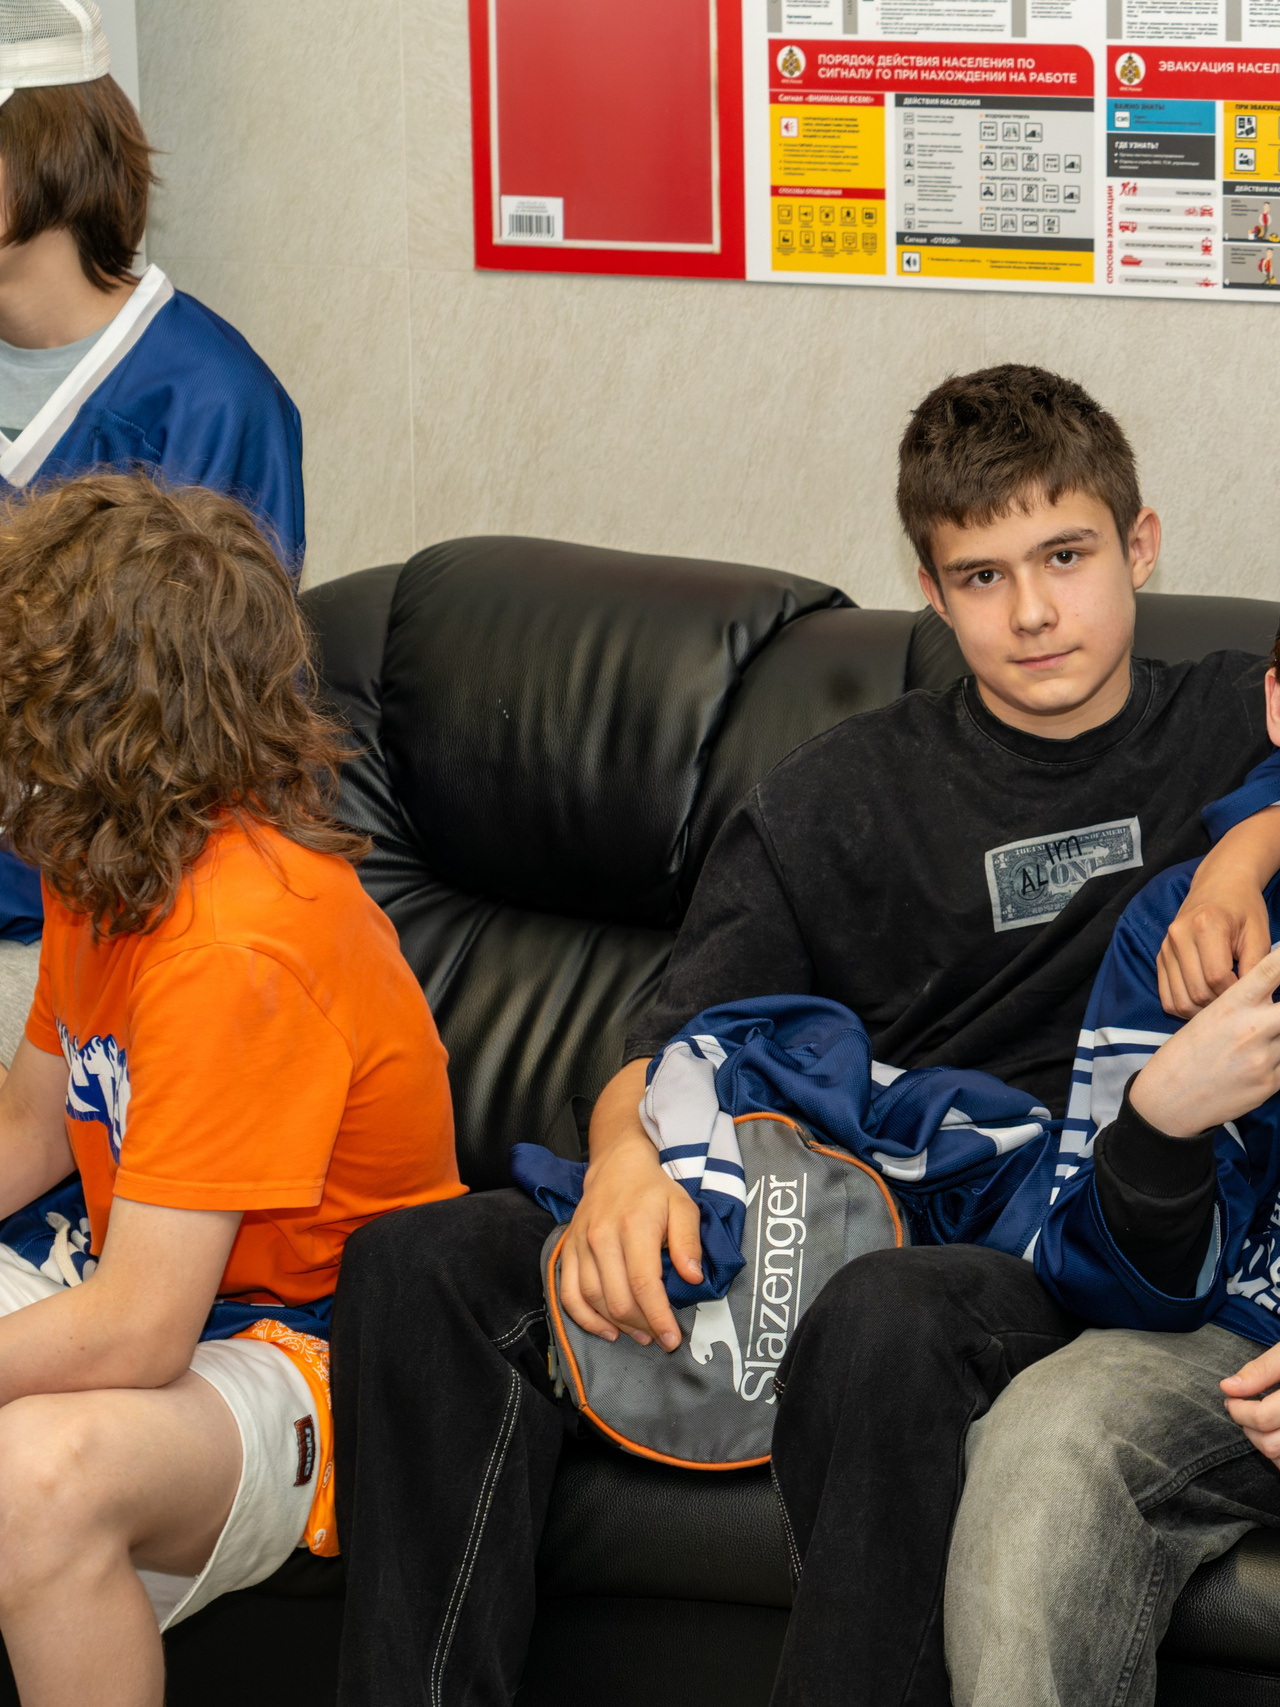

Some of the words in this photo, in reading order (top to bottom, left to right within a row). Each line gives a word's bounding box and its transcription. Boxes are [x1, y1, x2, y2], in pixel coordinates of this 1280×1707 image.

[818, 54, 875, 67] ПОРЯДОК
[877, 53, 940, 67] ДЕЙСТВИЯ
[942, 56, 1015, 69] НАСЕЛЕНИЯ
[1017, 58, 1035, 69] ПО
[818, 67, 873, 79] СИГНАЛУ
[875, 68, 892, 80] ГО
[894, 69, 918, 80] ПРИ
[920, 69, 1006, 83] НАХОЖДЕНИИ
[1009, 72, 1027, 82] НА
[1029, 72, 1077, 84] РАБОТЕ
[1158, 60, 1234, 74] ЭВАКУАЦИЯ
[1106, 185, 1114, 238] ЭВАКУАЦИИ
[1106, 241, 1114, 284] СПОСОБЫ
[741, 1174, 807, 1405] Slazenger
